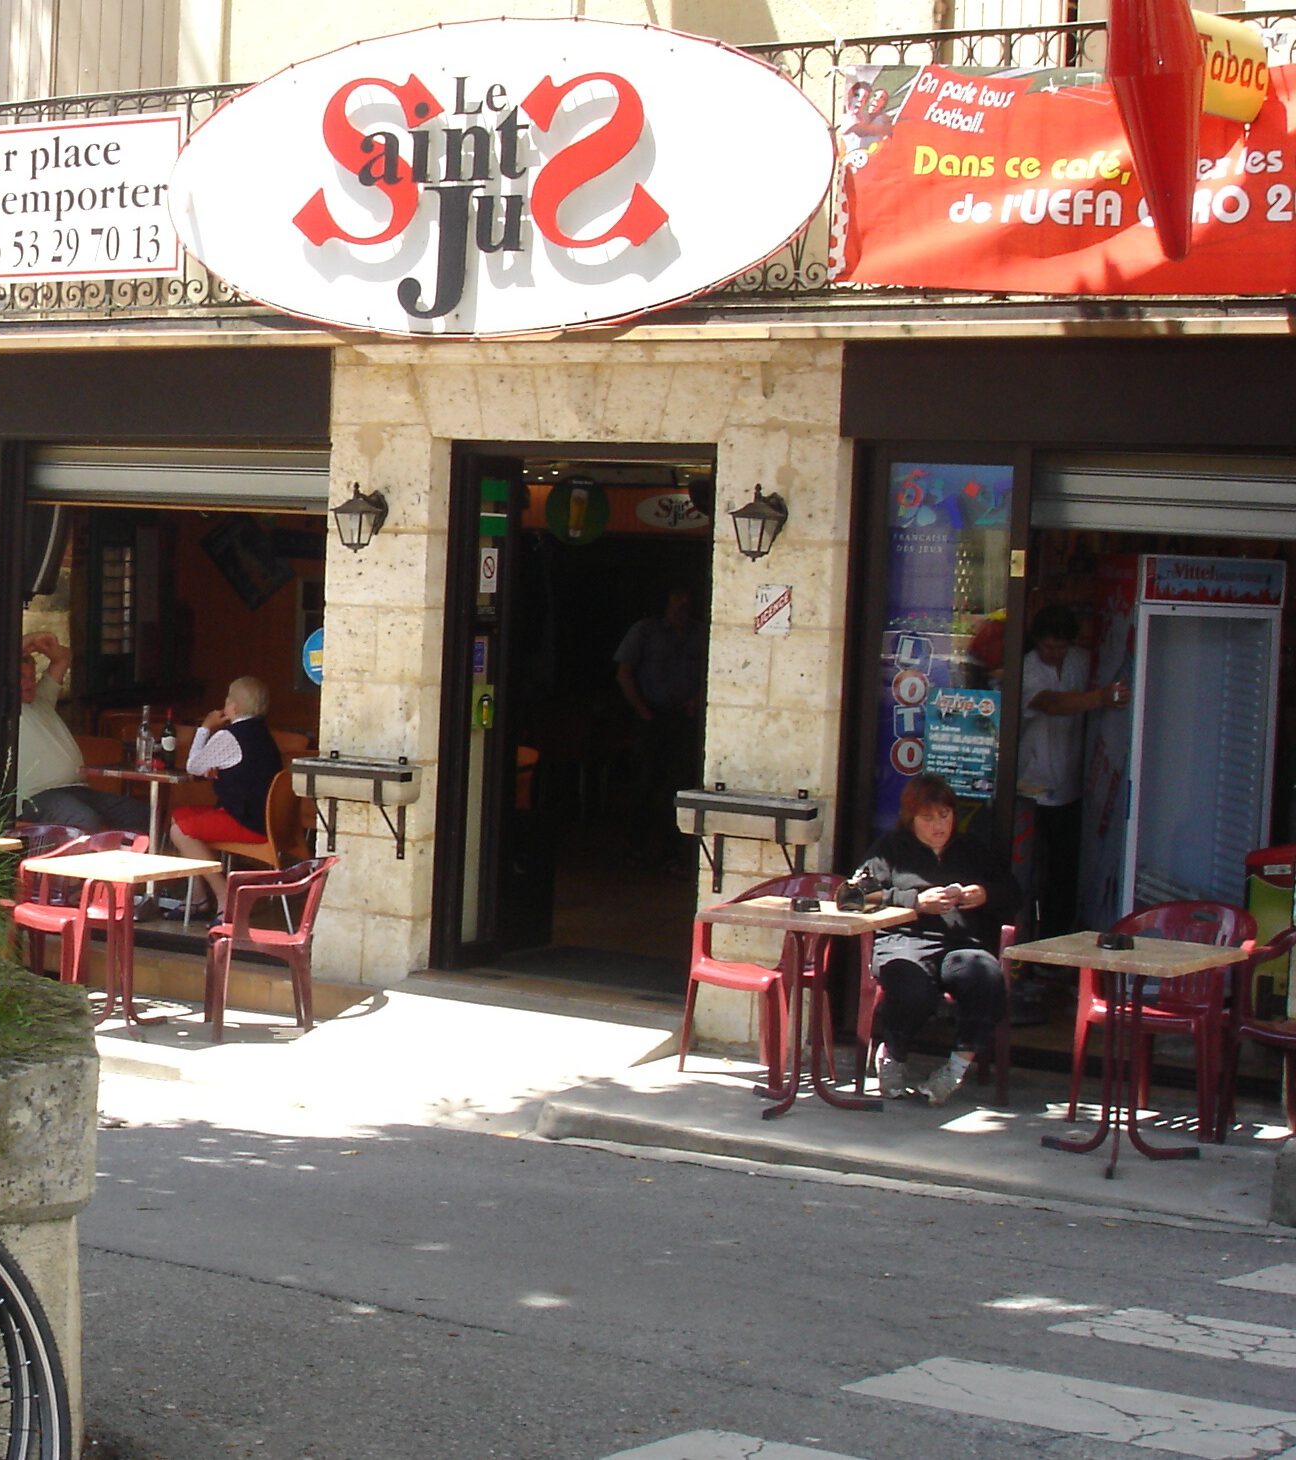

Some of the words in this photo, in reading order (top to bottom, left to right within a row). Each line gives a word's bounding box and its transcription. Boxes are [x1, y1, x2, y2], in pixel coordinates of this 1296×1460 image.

[452, 75, 508, 116] Le
[917, 72, 939, 94] On
[978, 85, 1016, 108] tous
[924, 102, 985, 134] football.
[30, 137, 122, 180] place
[913, 145, 995, 177] Dans
[1005, 153, 1040, 180] ce
[1050, 147, 1132, 186] café,
[1235, 147, 1284, 176] les
[0, 181, 170, 223] emporter
[948, 193, 993, 225] de
[1000, 188, 1122, 227] l'UEFA
[11, 229, 40, 268] 53
[51, 227, 80, 267] 29
[90, 225, 120, 264] 70
[132, 224, 161, 264] 13
